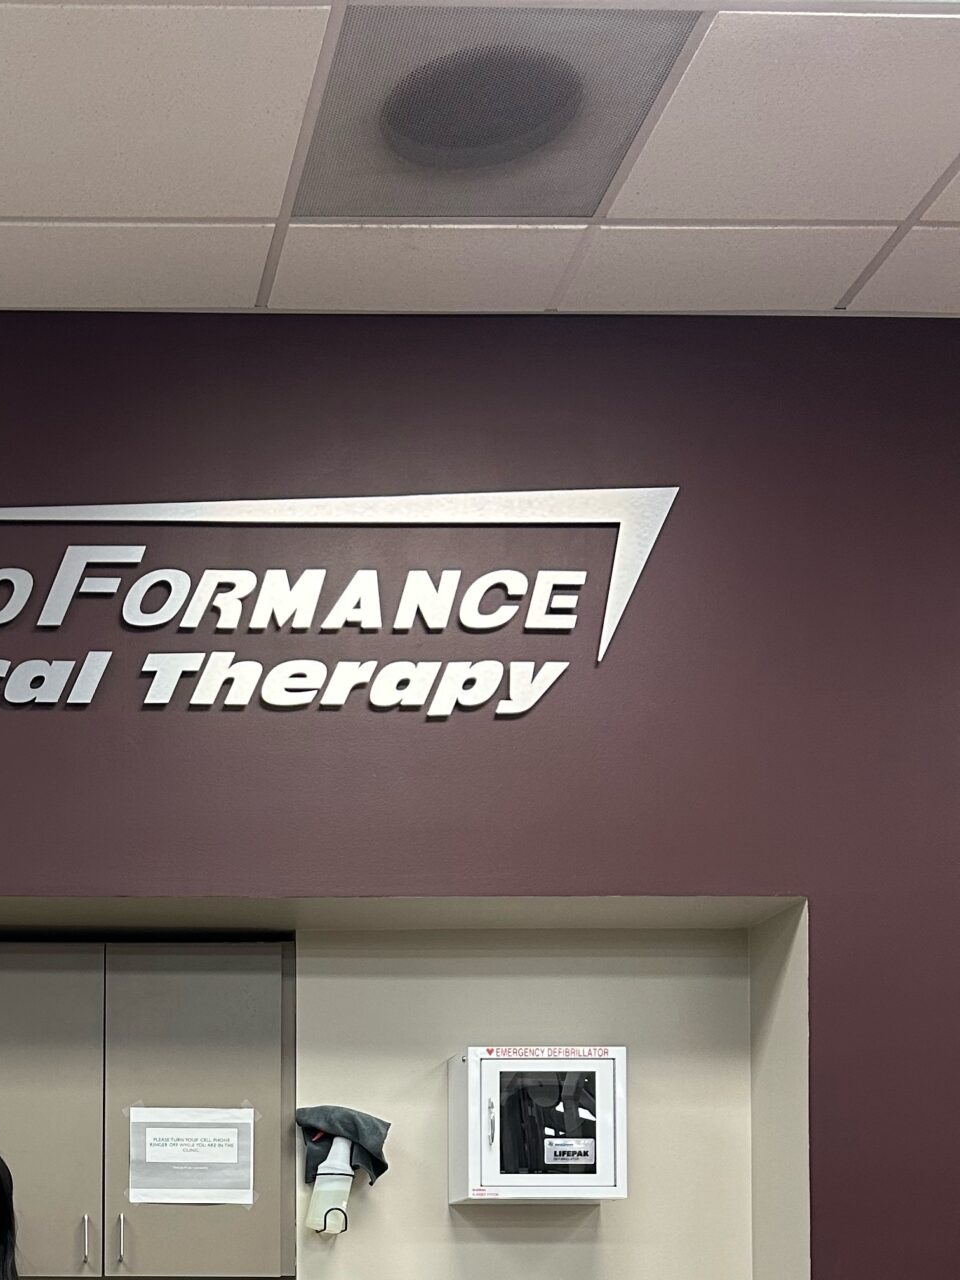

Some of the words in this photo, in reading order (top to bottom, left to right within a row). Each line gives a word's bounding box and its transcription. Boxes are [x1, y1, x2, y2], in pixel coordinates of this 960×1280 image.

[140, 651, 570, 717] Therapy
[495, 1047, 545, 1057] EMERGENCY
[547, 1047, 609, 1057] DEFIBRILLATOR
